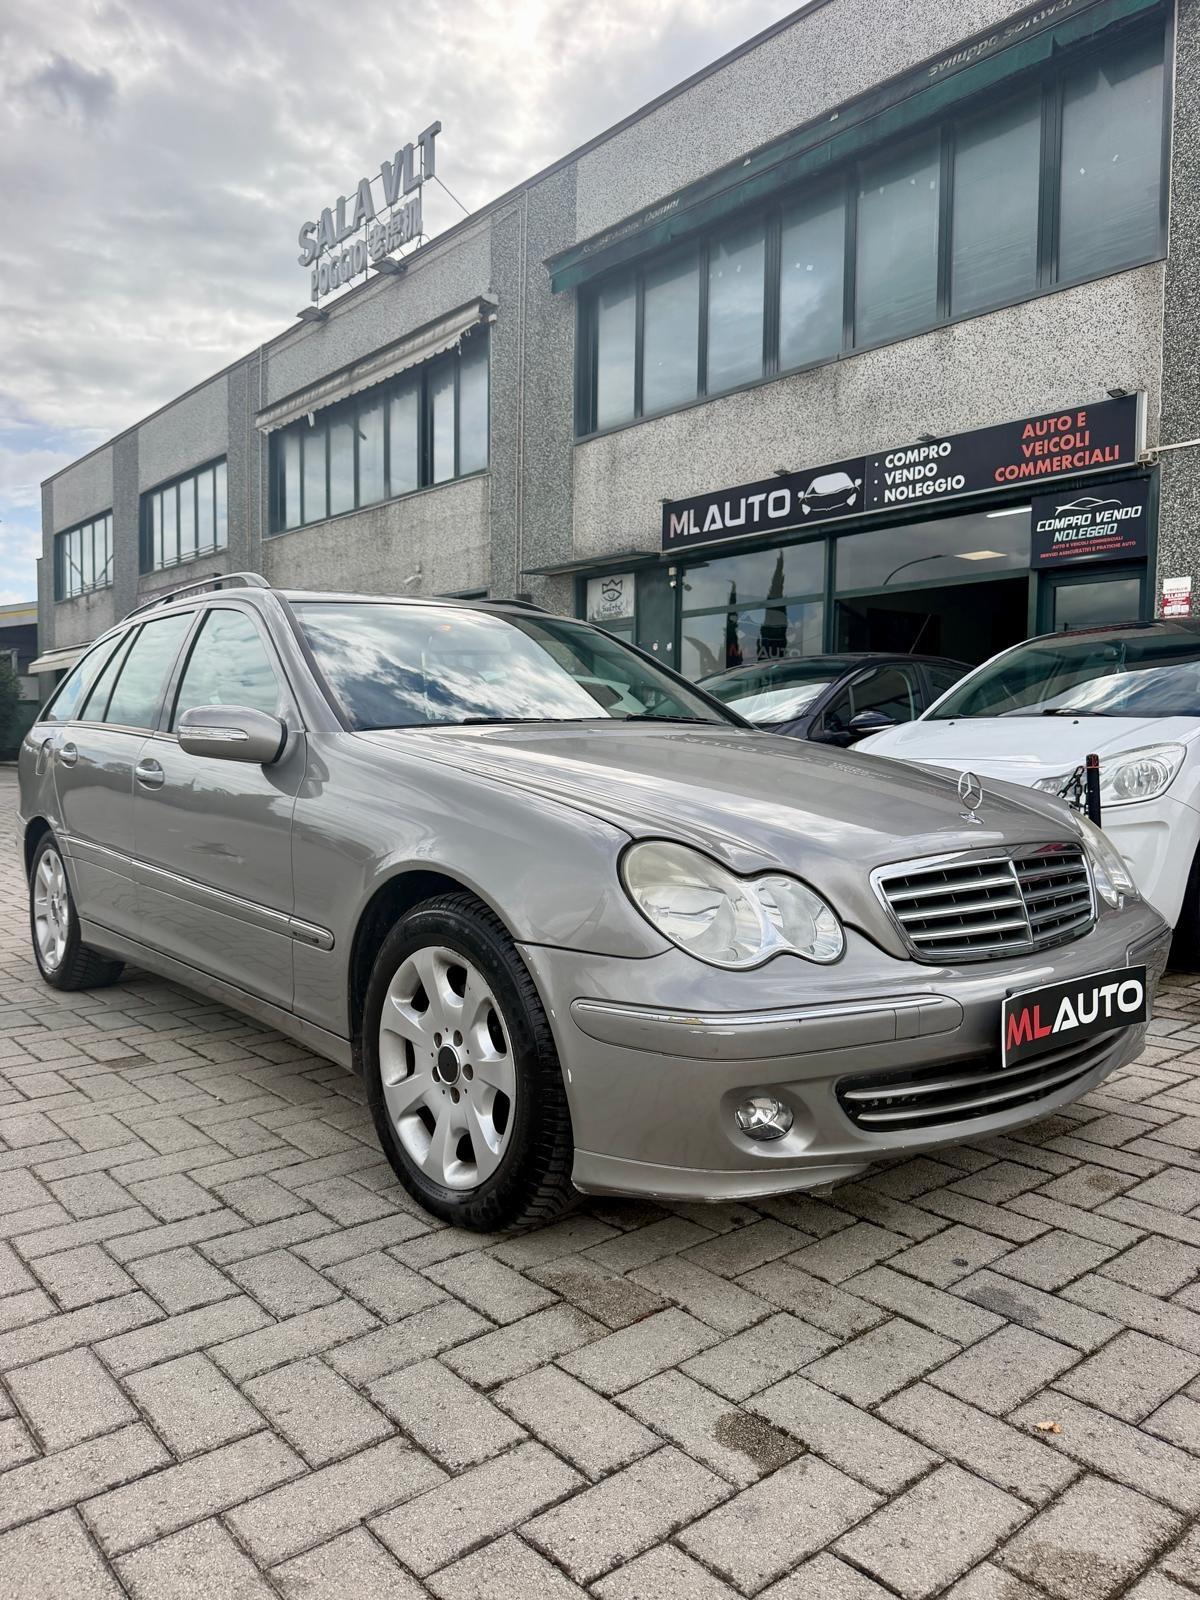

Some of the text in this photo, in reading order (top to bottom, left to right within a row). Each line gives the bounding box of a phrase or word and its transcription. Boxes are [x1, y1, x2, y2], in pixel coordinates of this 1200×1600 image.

[298, 120, 442, 267] SALA VLT
[1021, 411, 1087, 440] AUTO E
[884, 441, 952, 469] COMPRO
[1021, 430, 1091, 458] VEICOLI
[884, 463, 938, 486] VENDO
[994, 444, 1120, 482] COMMERCIALI
[884, 474, 966, 503] NOLEGGIO
[1036, 505, 1143, 532] COMPRO VENDO
[1053, 523, 1118, 543] NOLEGGIO
